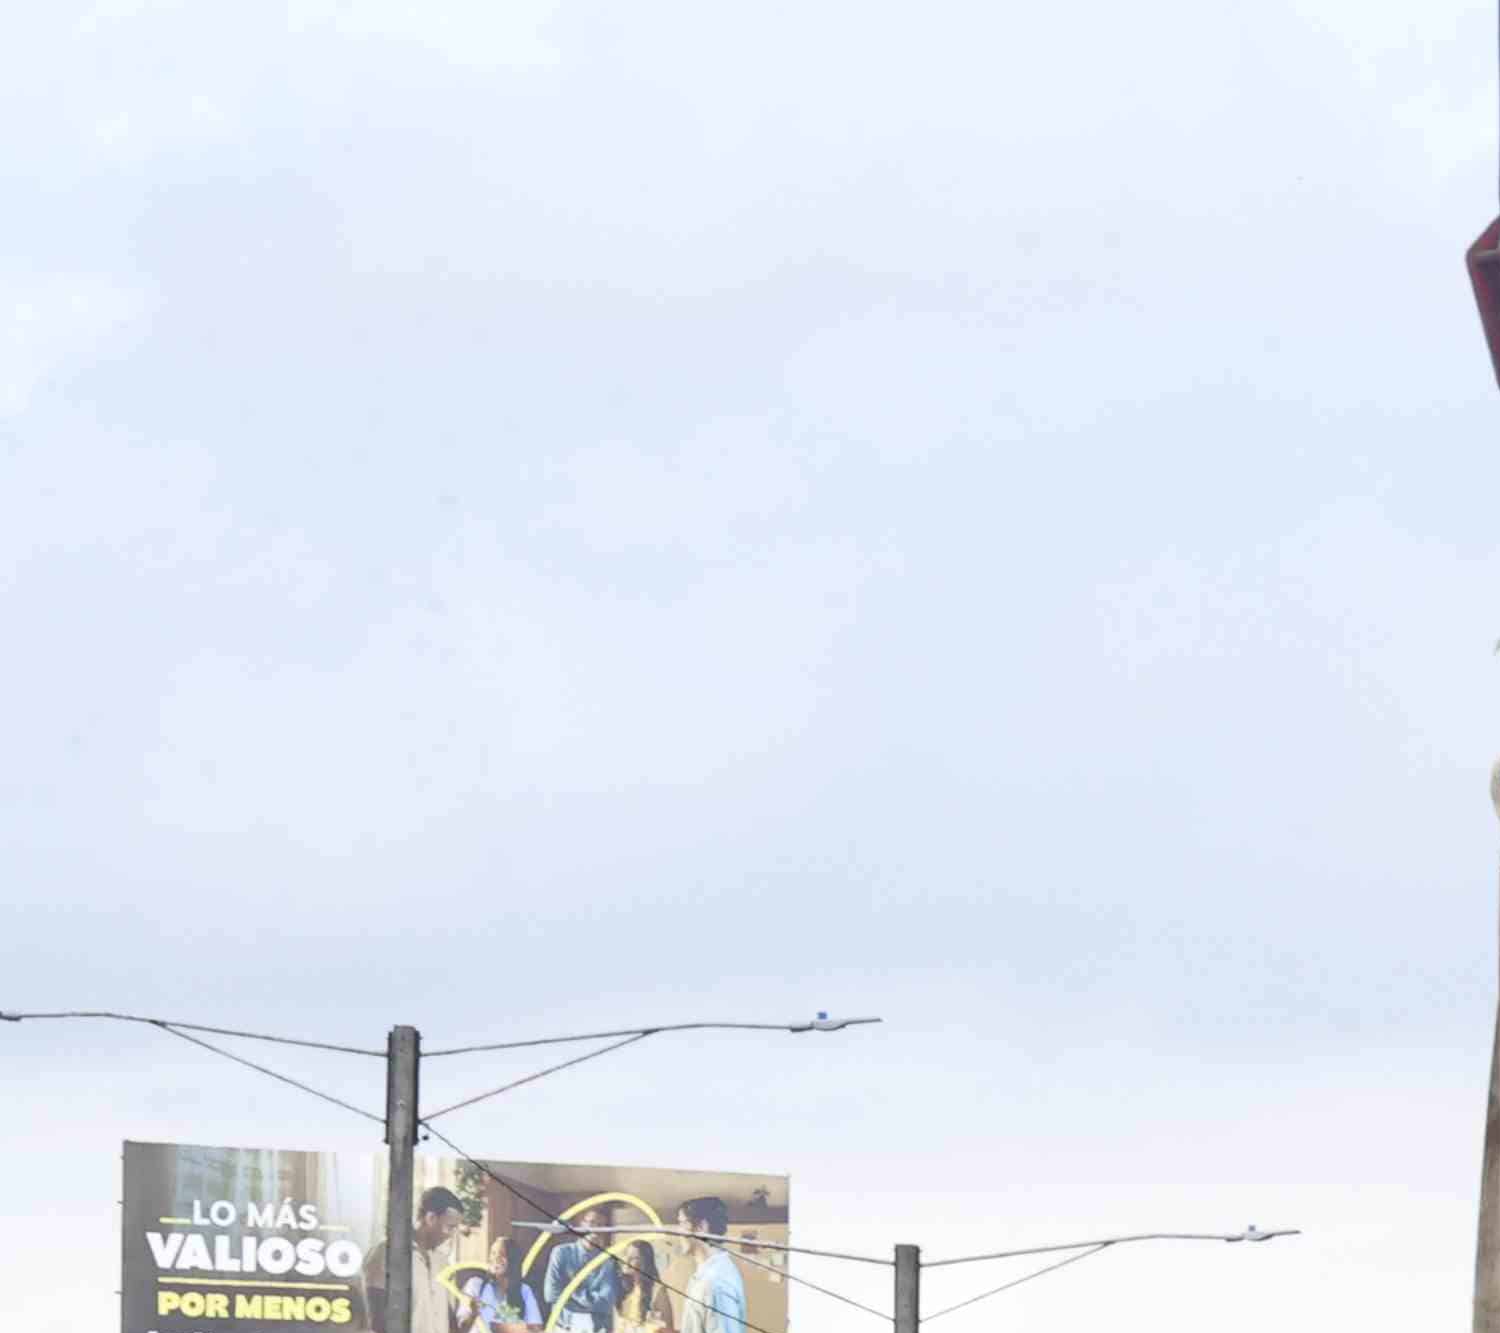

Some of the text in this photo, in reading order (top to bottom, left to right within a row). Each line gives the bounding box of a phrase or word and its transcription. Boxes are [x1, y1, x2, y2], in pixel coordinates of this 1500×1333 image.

[193, 1197, 318, 1231] LO MÁS
[146, 1232, 363, 1277] VALIOSO
[157, 1291, 352, 1323] POR MENOS
